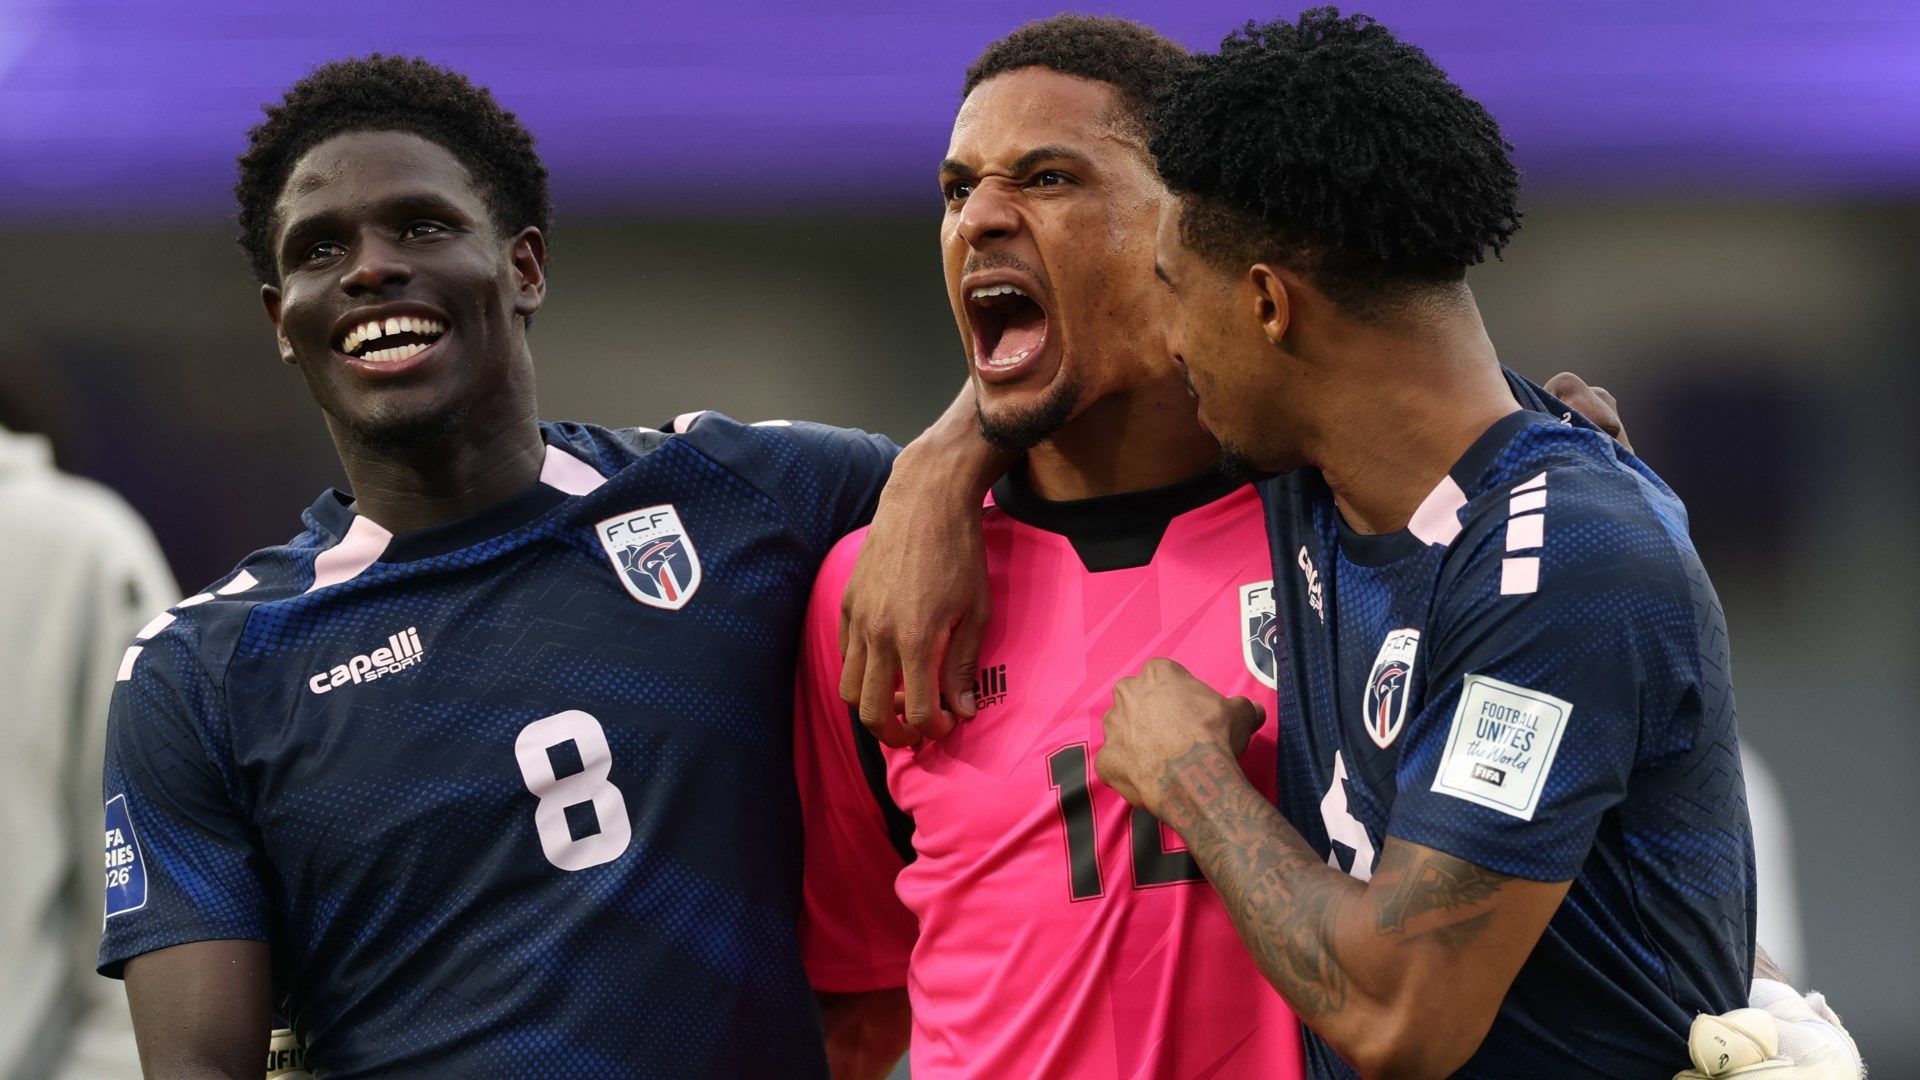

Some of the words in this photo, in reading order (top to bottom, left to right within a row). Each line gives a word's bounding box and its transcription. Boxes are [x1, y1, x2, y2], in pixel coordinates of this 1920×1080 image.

[607, 511, 669, 542] FCF
[1248, 587, 1277, 606] F
[309, 626, 423, 694] capelli
[364, 651, 424, 682] SPORT
[1481, 701, 1539, 731] FOOTBALL
[1476, 717, 1535, 752] UNITES
[1466, 740, 1485, 757] the
[1486, 746, 1532, 774] World
[514, 709, 632, 871] 8
[1473, 765, 1502, 784] FIFA
[105, 866, 130, 889] 26
